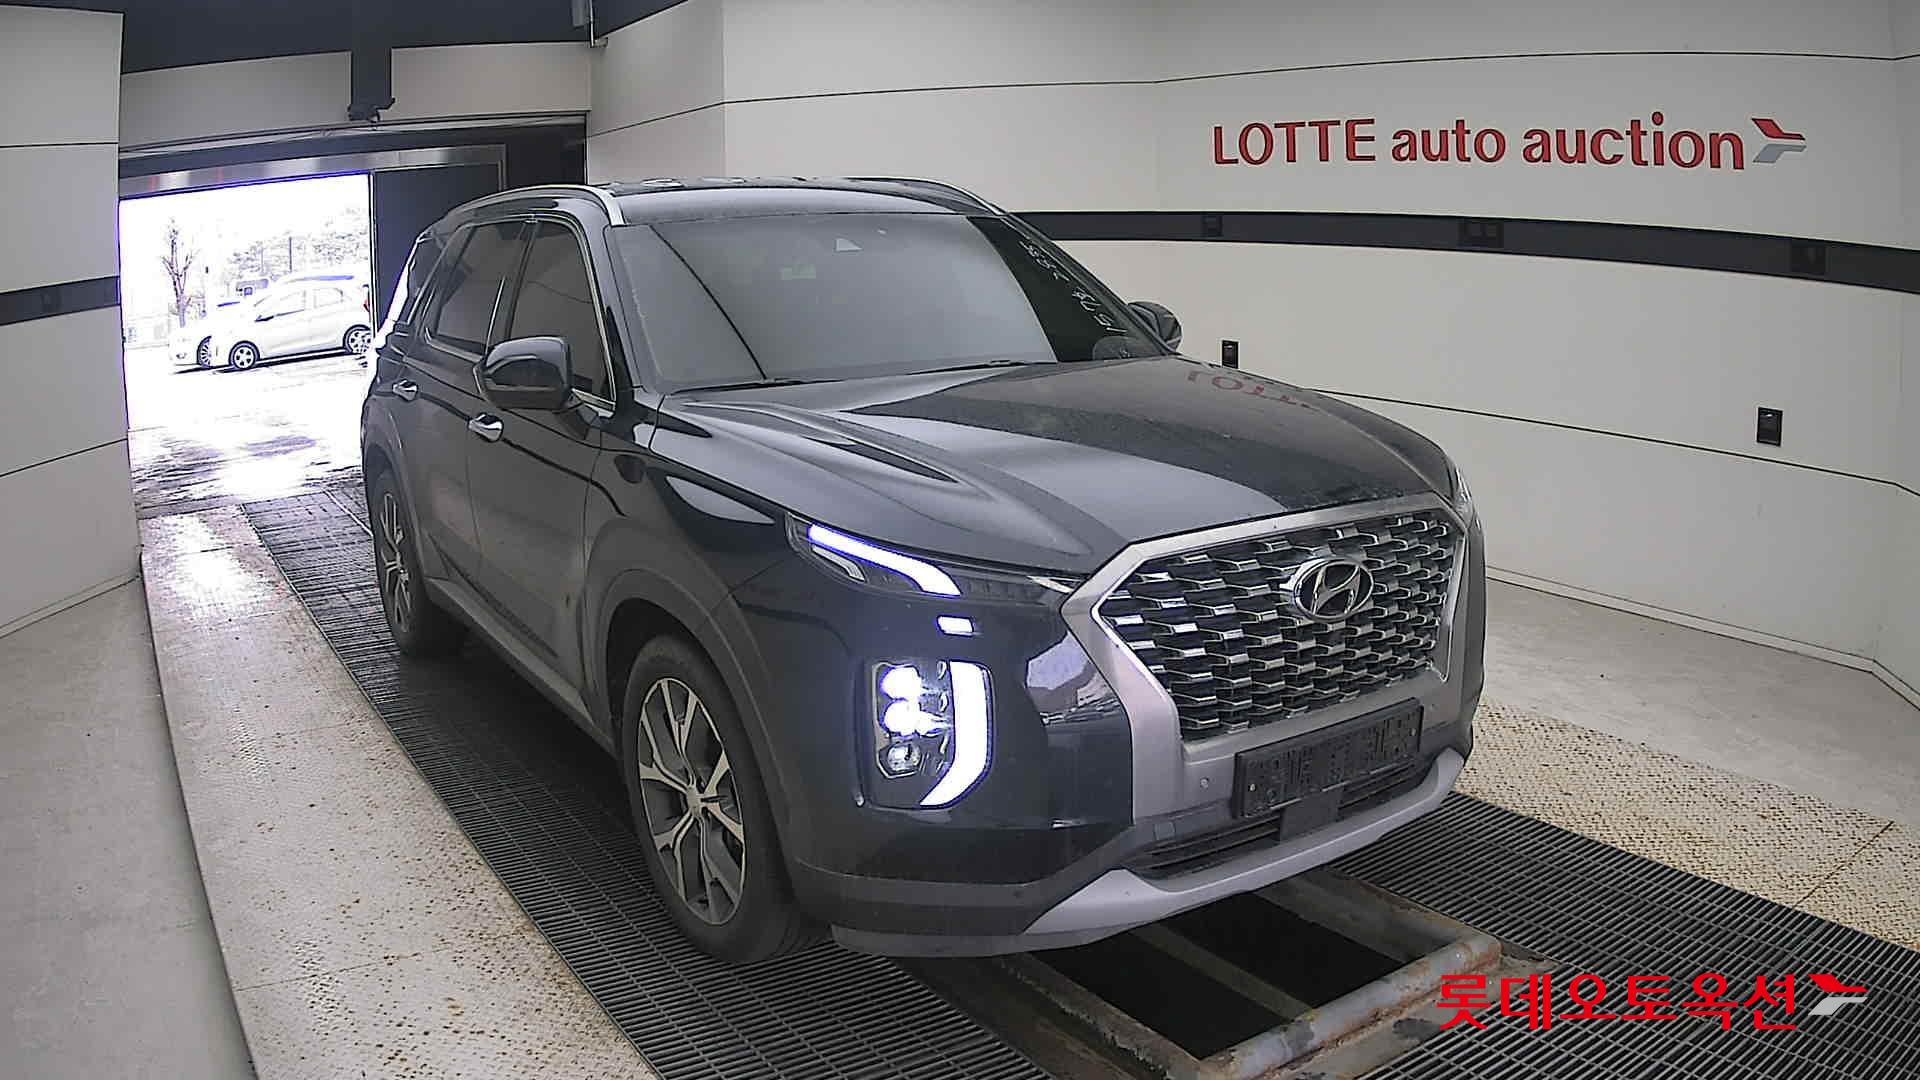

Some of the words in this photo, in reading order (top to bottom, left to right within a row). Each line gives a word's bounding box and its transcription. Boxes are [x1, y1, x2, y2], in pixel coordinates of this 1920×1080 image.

[1213, 118, 1376, 165] LOTTE
[1391, 119, 1506, 162] auto
[1522, 112, 1744, 169] auction
